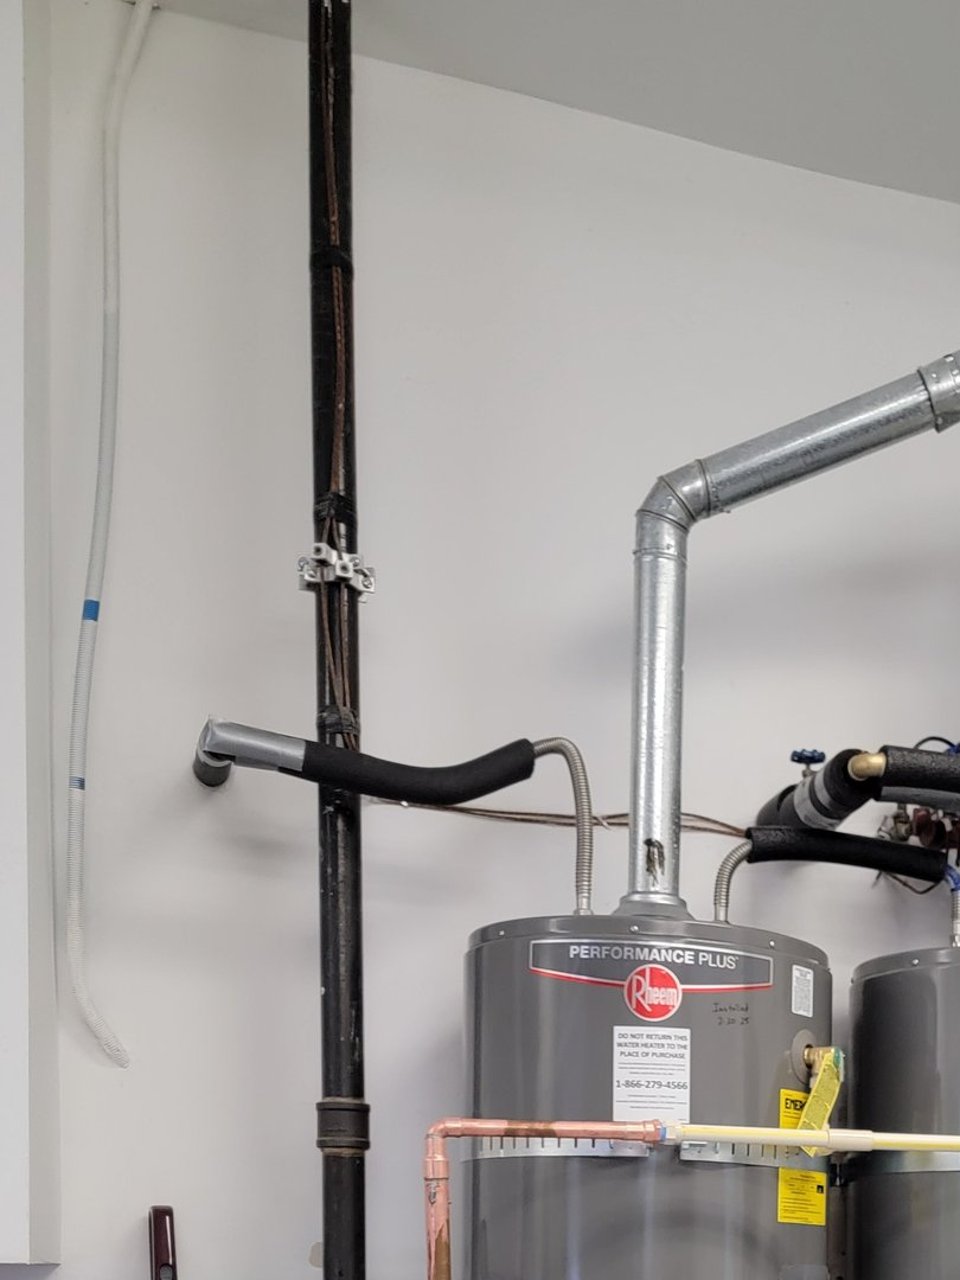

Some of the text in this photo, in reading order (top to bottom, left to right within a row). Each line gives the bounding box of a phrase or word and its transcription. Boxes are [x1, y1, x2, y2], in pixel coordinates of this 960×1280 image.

[569, 945, 695, 965] PERFORMANCE
[631, 967, 680, 1011] Rheem
[615, 1080, 688, 1089] 1-866-279-4566
